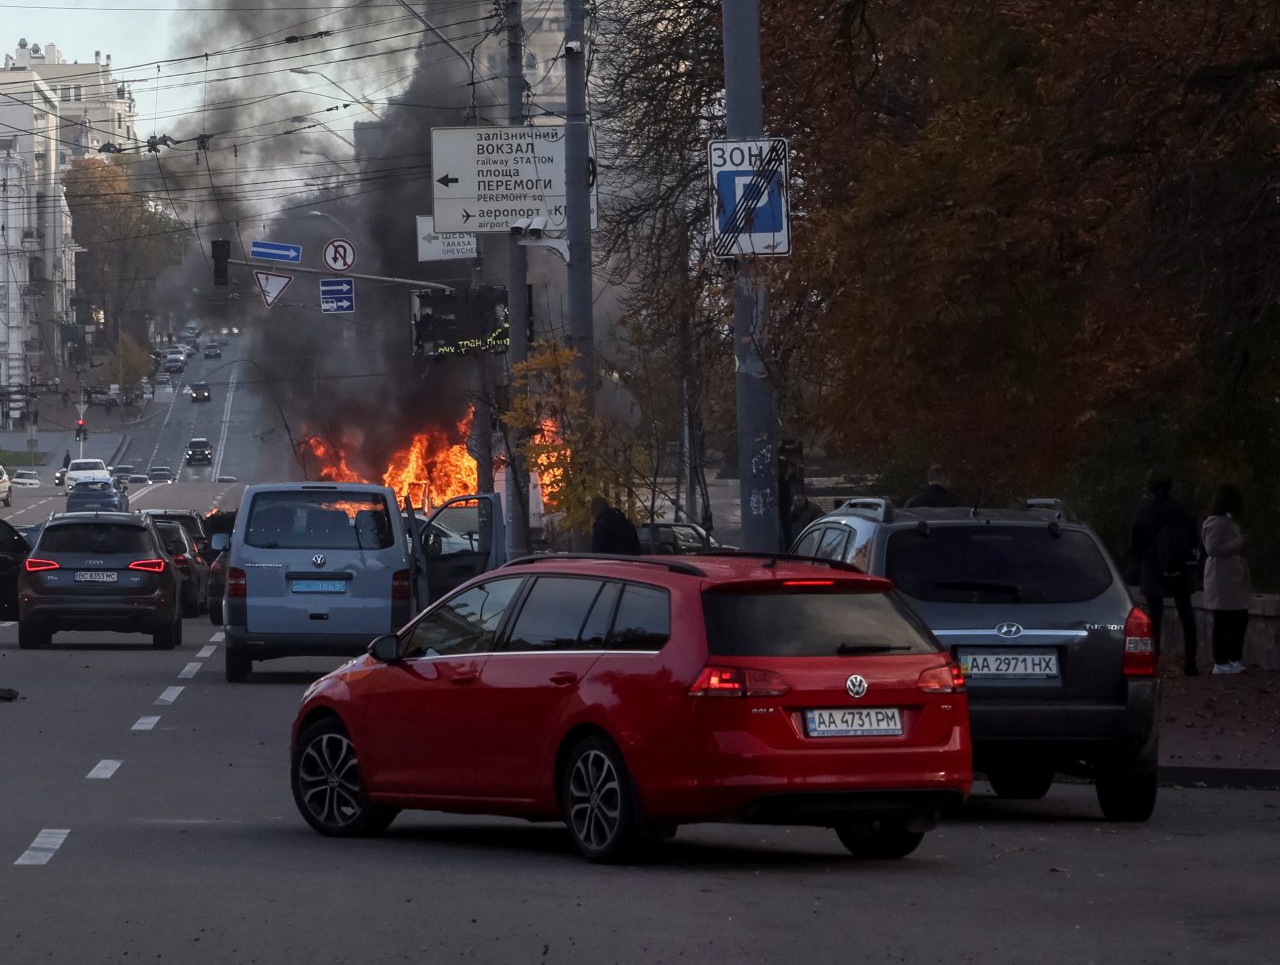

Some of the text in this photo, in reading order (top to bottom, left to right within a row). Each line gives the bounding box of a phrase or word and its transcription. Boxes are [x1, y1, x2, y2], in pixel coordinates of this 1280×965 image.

[476, 129, 559, 141] залізничний
[477, 143, 534, 155] ВОКЗАЛ
[476, 156, 554, 166] railway STATION
[477, 169, 519, 178] площа
[477, 179, 552, 191] ПЕРЕМОГИ
[477, 194, 528, 202] PEREMOHY
[478, 208, 541, 219] аеропорт
[478, 220, 509, 229] airport
[442, 240, 471, 248] TARASA
[442, 247, 477, 255] SHEVCHE
[970, 657, 1053, 673] AA 2971 HX
[818, 711, 897, 728] AA 4731 PM
